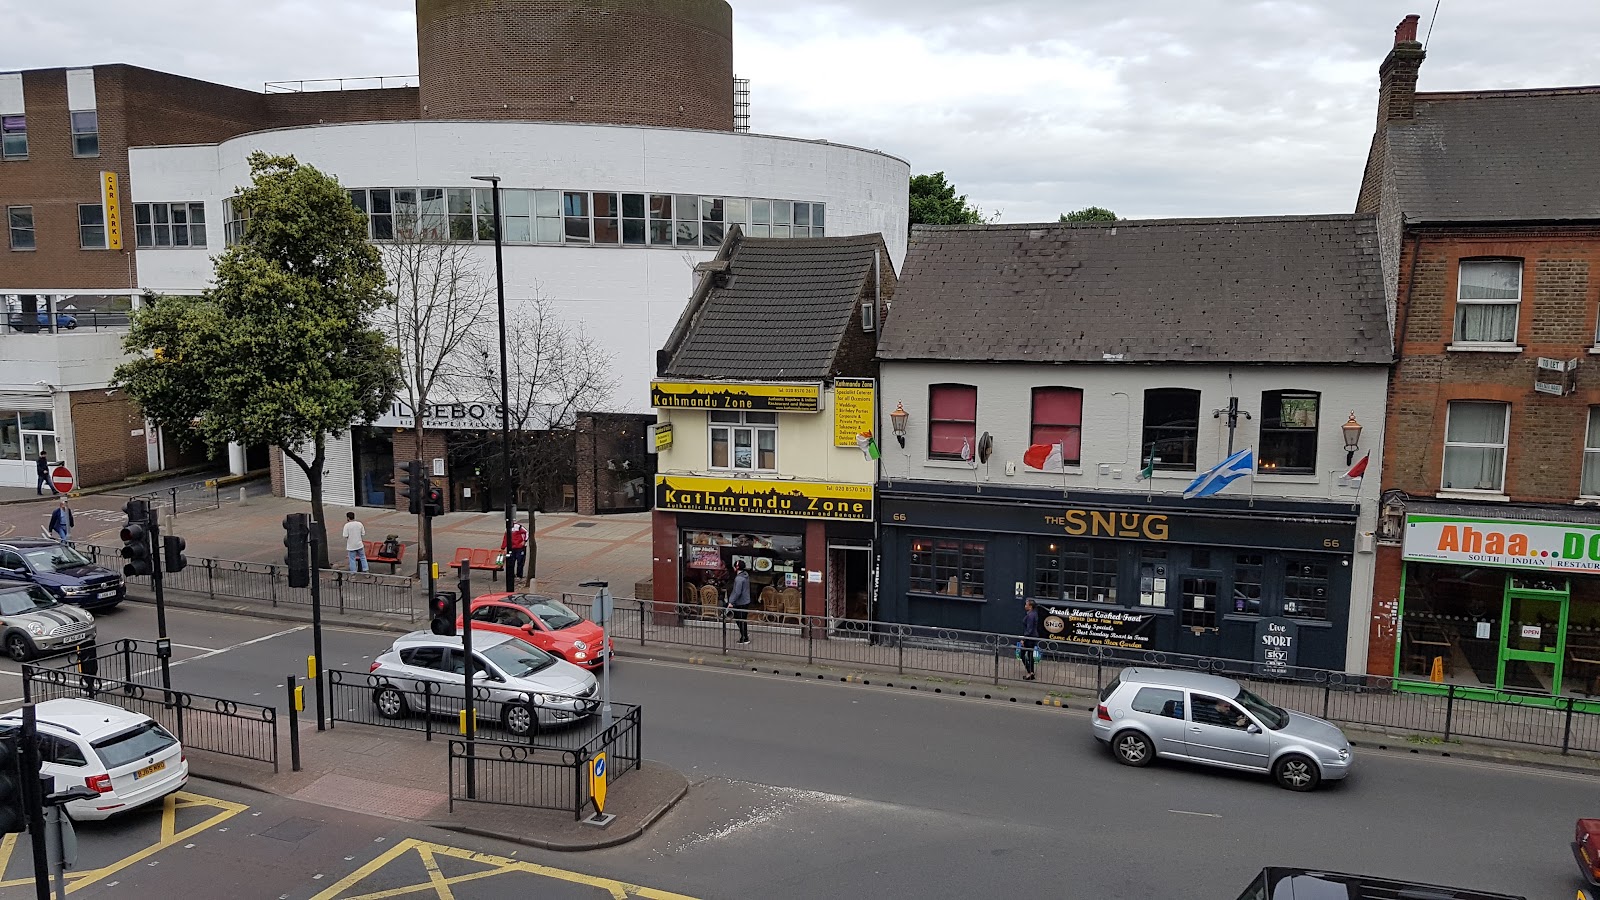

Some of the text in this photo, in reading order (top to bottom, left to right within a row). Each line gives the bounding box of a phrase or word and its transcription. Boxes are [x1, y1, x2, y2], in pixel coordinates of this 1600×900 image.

[1542, 360, 1560, 369] TO LET
[653, 394, 753, 409] Kathmandu Zone
[665, 489, 863, 513] Kathmandu Zone
[667, 502, 701, 510] Authentic
[704, 504, 737, 512] Nepalese
[774, 508, 814, 516] Restaurant
[834, 511, 864, 519] Banquet
[893, 513, 906, 521] 66
[1044, 509, 1169, 540] THE SNUG
[1323, 538, 1340, 548] 66
[1468, 554, 1600, 569] SOUTH INDIAN RESTAUR
[1049, 606, 1142, 622] Fresh Home Cooked Food
[1075, 622, 1114, 632] Daily Specials
[1268, 622, 1287, 632] Live
[1089, 630, 1110, 639] Sunday
[1110, 632, 1127, 640] Roast
[1262, 635, 1292, 647] SPORT
[1072, 635, 1091, 644] Enjoy
[1103, 638, 1118, 646] Beer
[1119, 639, 1142, 649] Garden
[1267, 650, 1285, 660] sky
